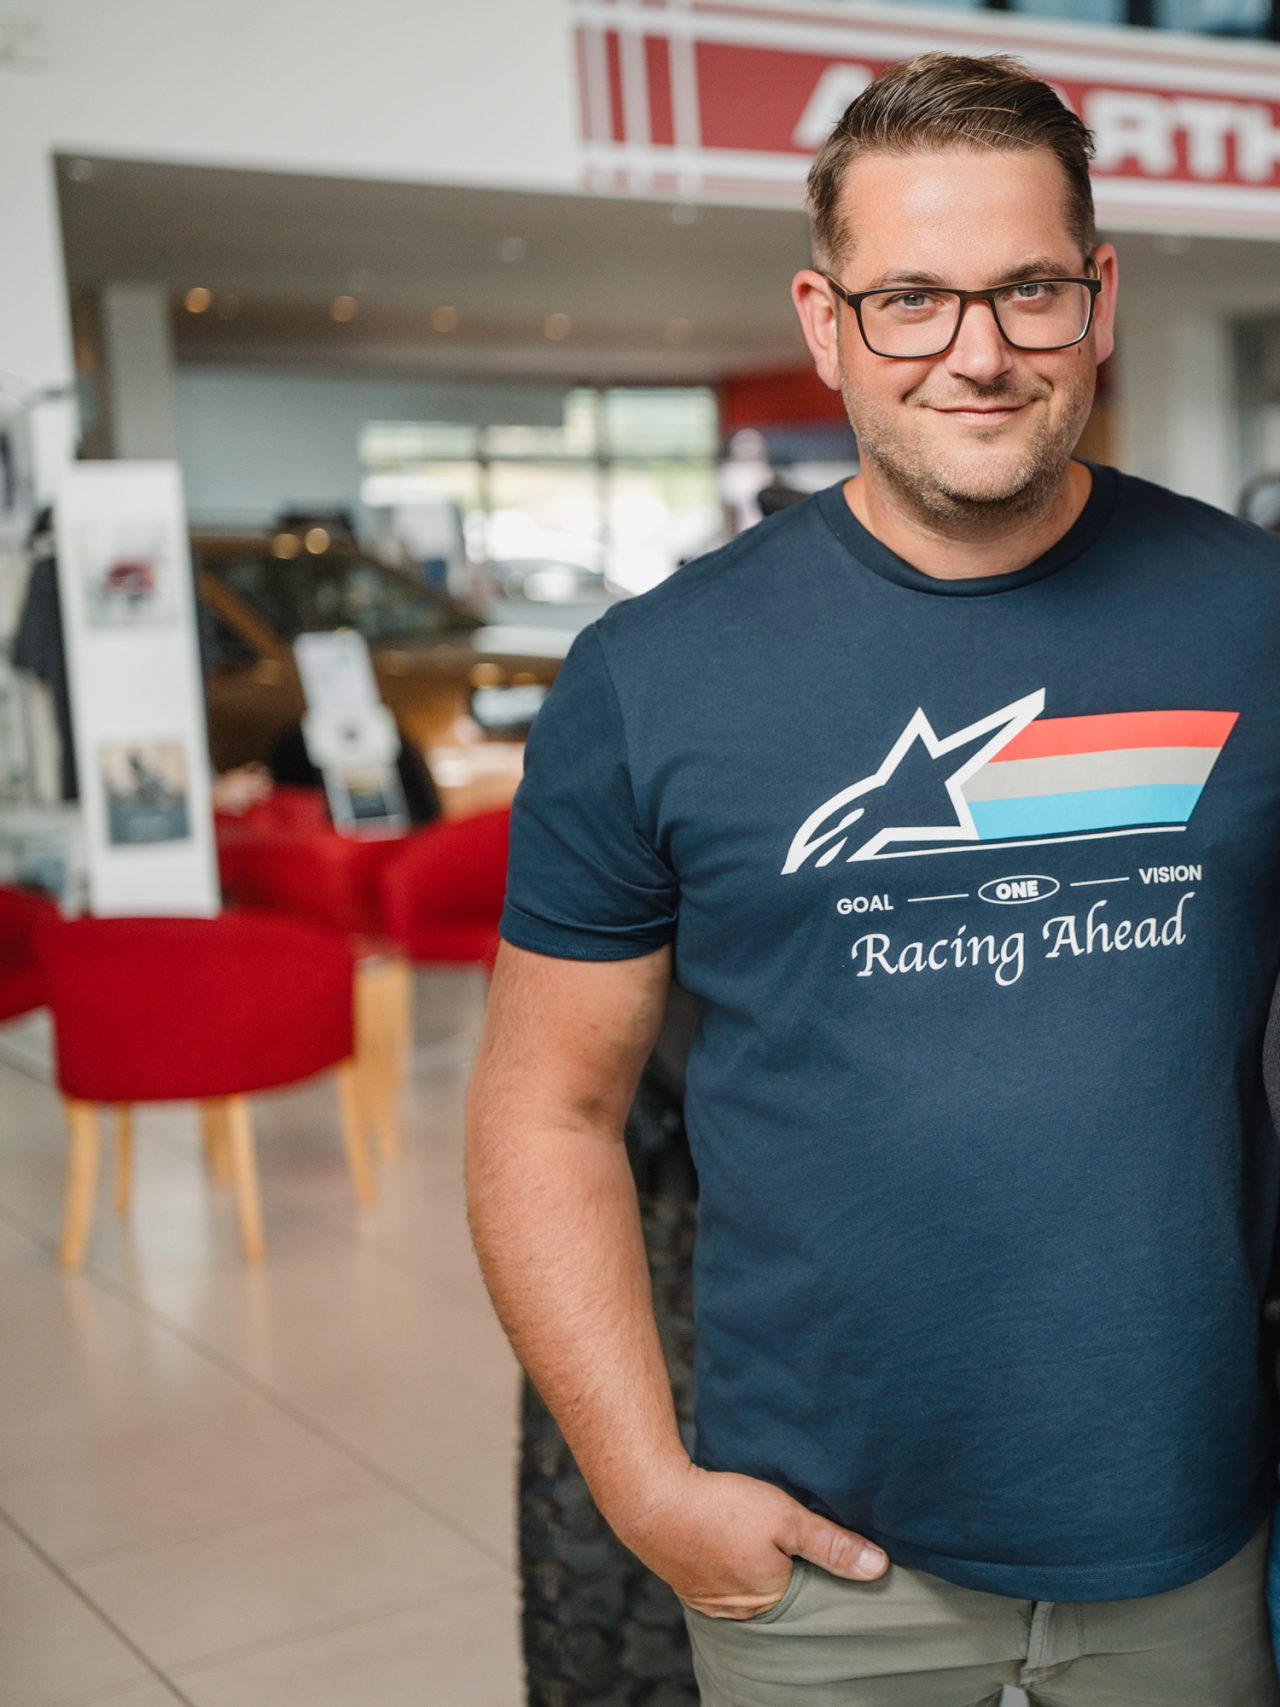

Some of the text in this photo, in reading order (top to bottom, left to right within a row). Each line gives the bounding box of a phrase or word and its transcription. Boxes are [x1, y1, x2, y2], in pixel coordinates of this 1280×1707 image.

[836, 864, 1203, 916] GOAL ONE VISION
[851, 891, 1196, 987] Racing Ahead
